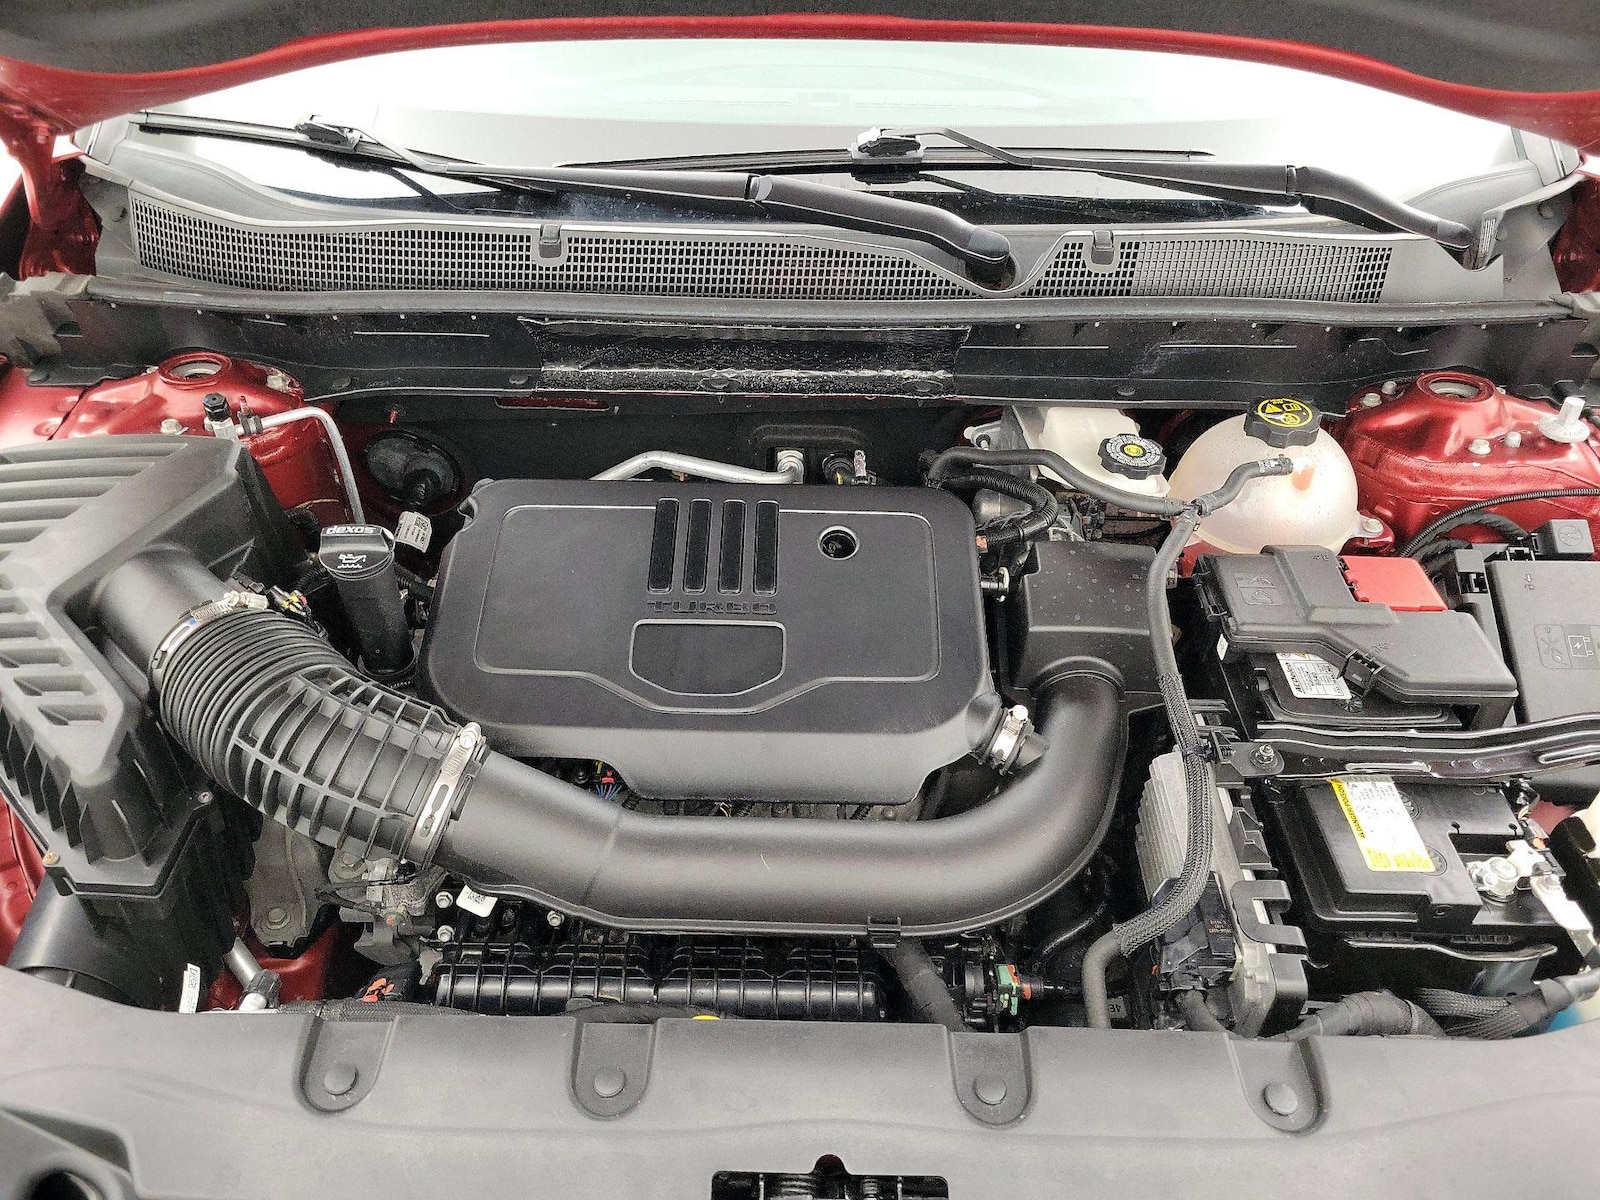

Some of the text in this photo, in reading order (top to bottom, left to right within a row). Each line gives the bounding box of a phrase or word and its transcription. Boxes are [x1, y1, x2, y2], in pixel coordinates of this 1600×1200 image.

[326, 525, 376, 534] dexos
[647, 601, 777, 615] TURBO
[1337, 784, 1362, 833] DANGER POISON
